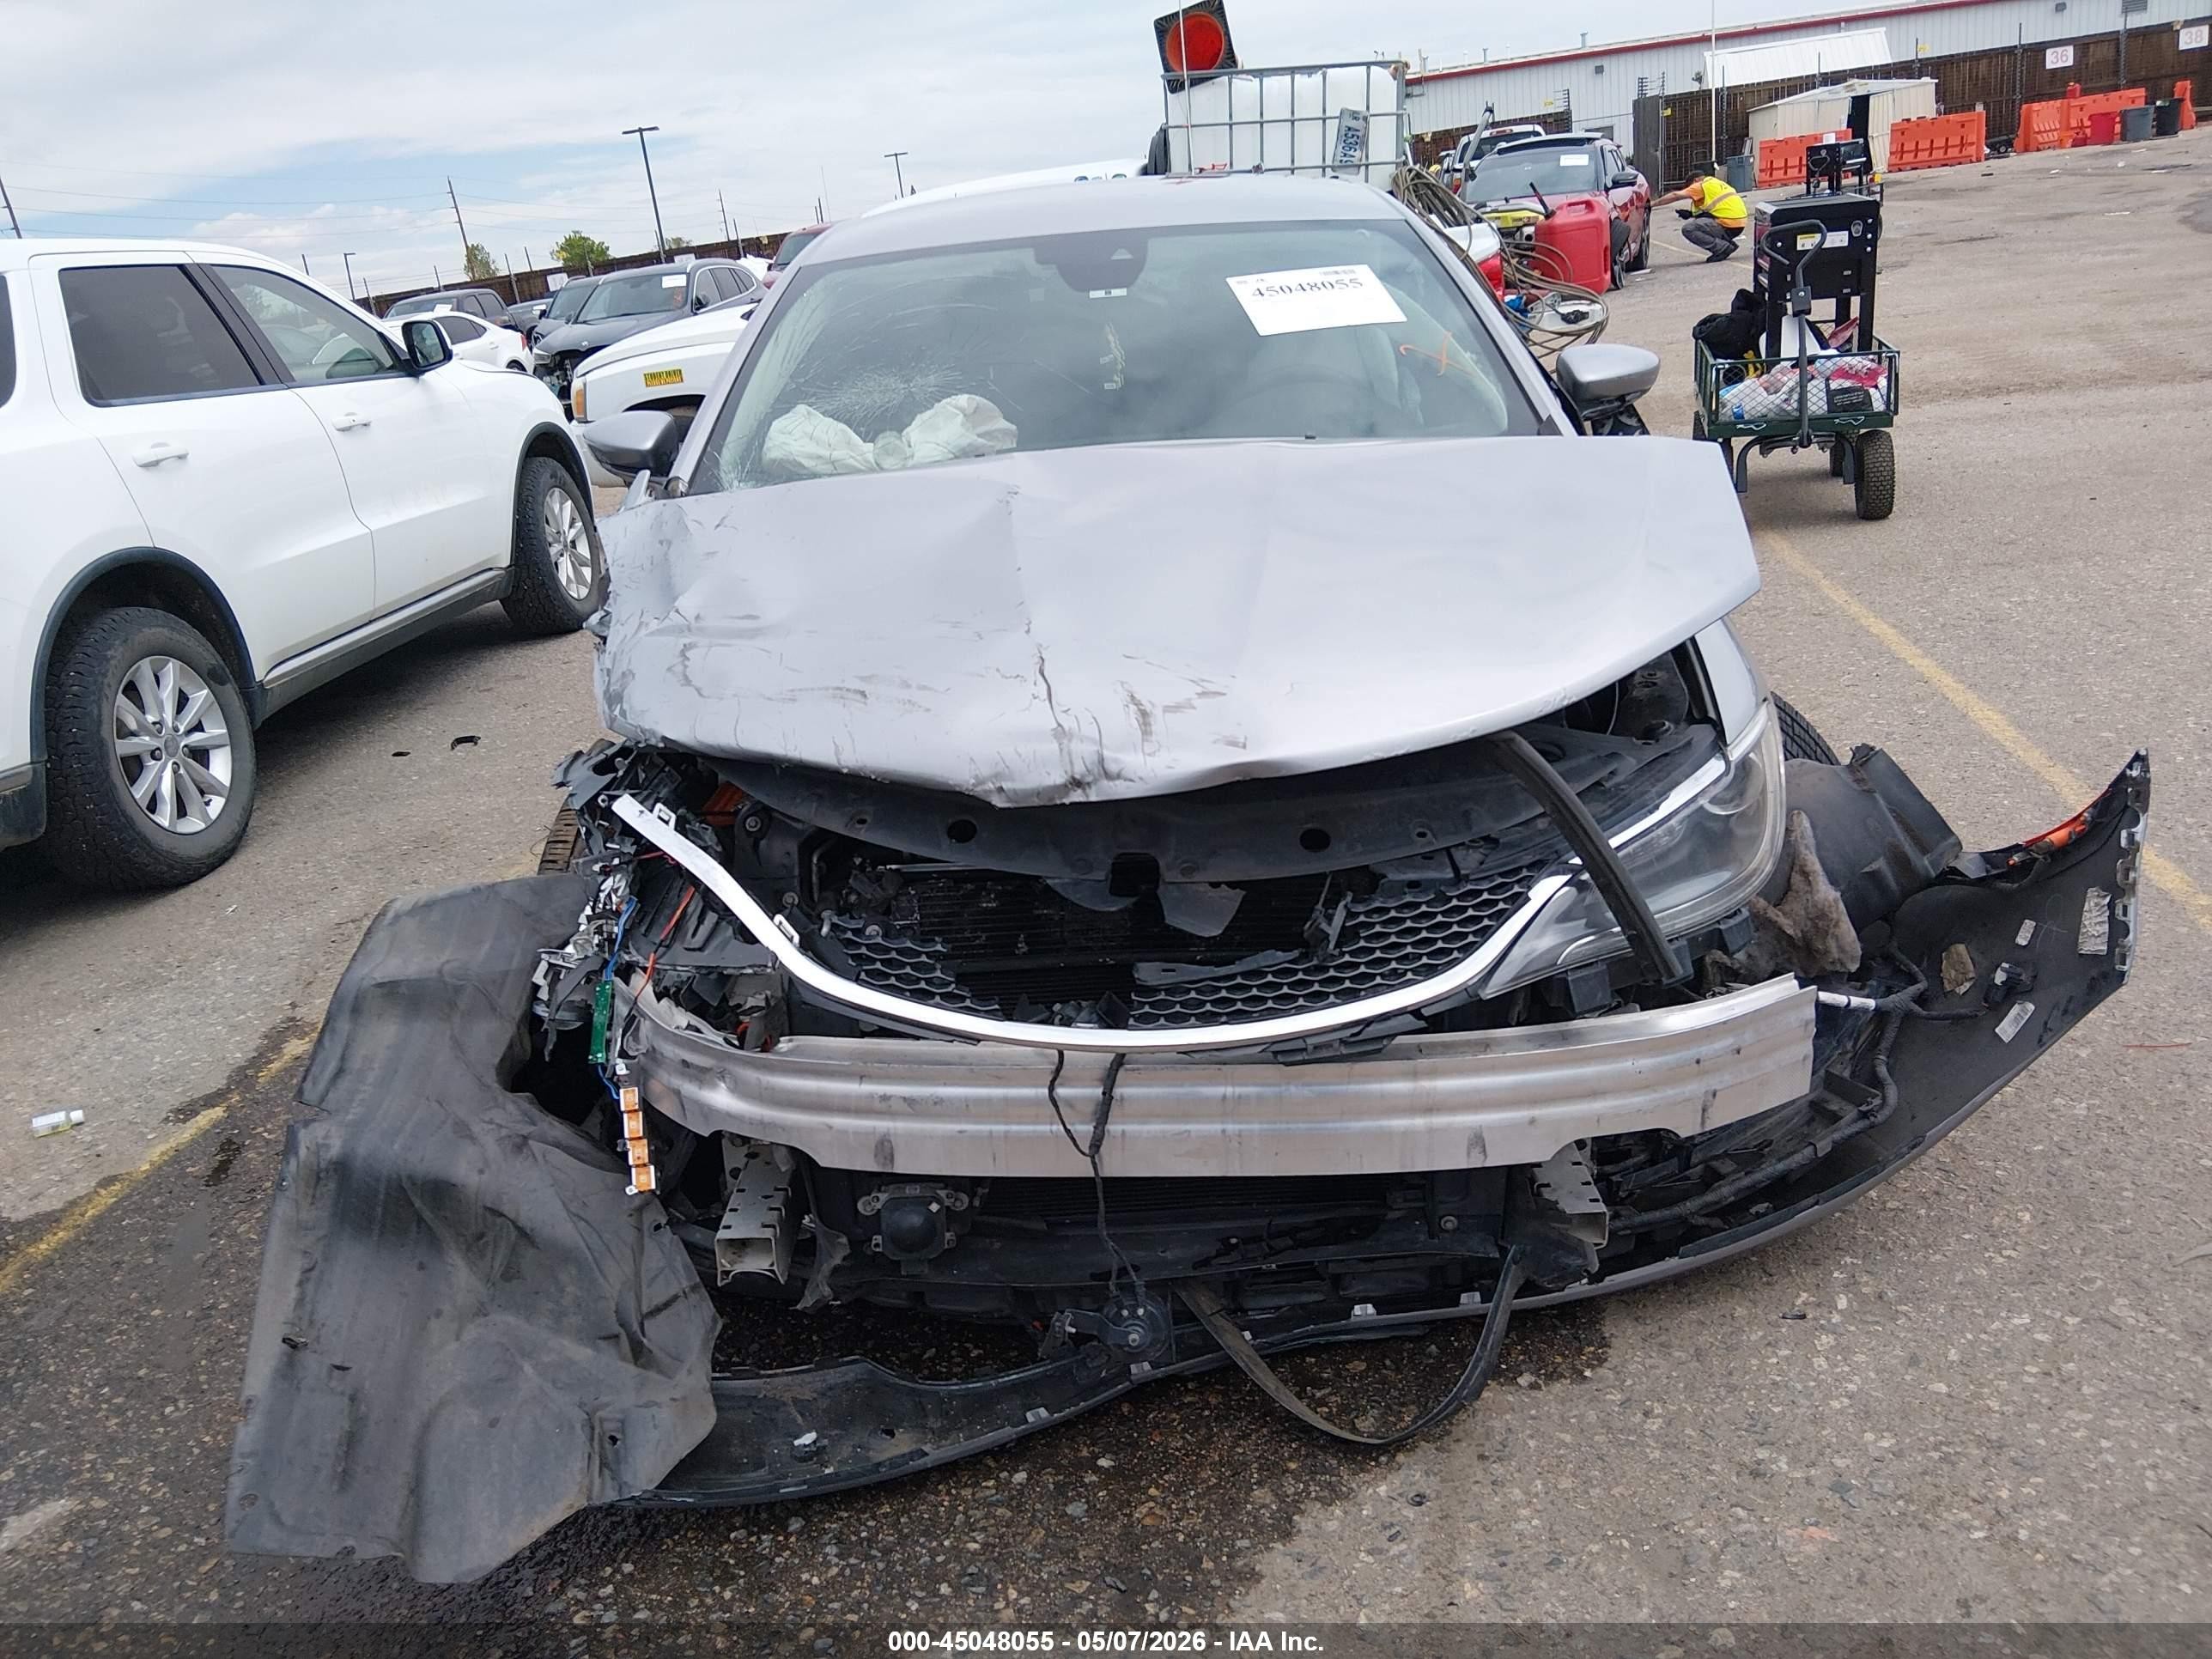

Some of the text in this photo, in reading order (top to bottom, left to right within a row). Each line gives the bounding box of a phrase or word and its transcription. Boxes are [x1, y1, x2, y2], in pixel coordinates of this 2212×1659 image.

[2184, 28, 2203, 45] 38
[2050, 48, 2069, 64] 36
[1251, 277, 1364, 298] 45048055
